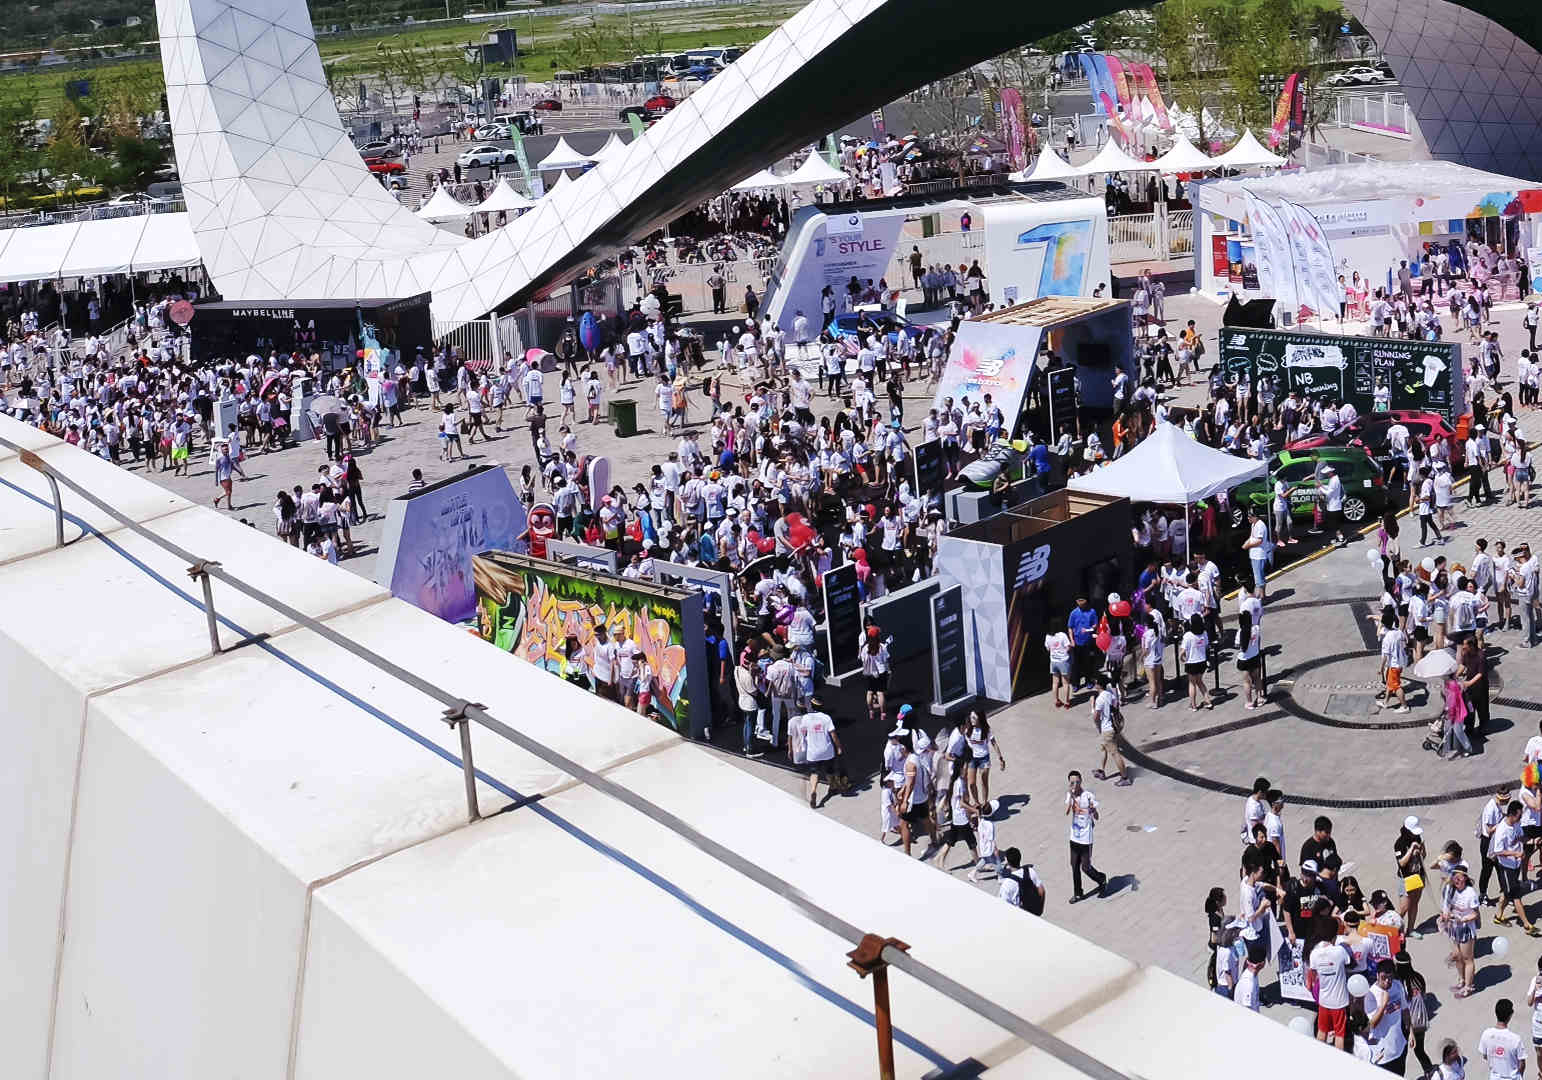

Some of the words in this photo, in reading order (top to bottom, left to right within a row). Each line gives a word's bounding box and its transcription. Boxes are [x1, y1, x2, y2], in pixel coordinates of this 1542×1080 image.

[839, 239, 885, 254] STYLE
[232, 308, 295, 319] MAYBELLINE
[1373, 349, 1413, 360] RUNNING
[1373, 358, 1395, 367] PLAN
[1295, 372, 1313, 386] NB
